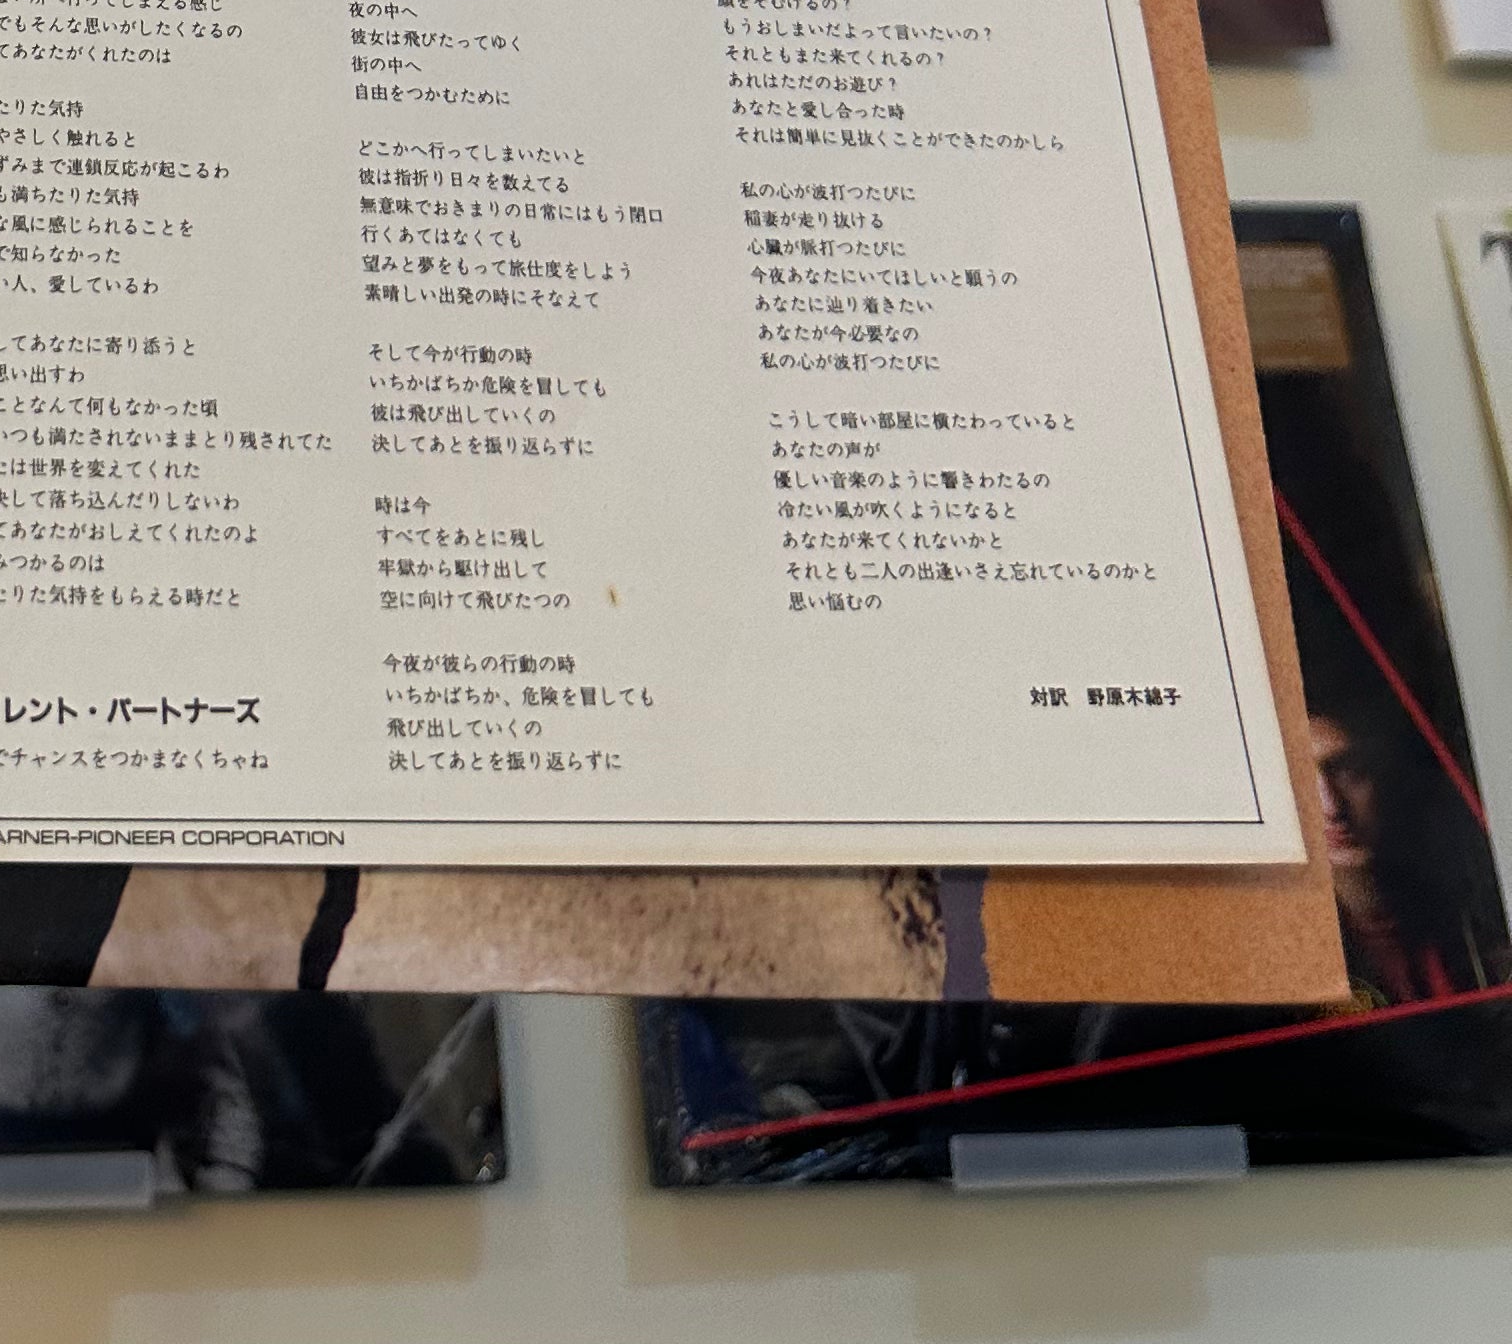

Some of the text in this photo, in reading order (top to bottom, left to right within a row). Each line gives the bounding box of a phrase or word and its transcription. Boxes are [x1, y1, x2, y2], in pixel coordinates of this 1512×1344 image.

[346, 0, 418, 20] 夜の中へ
[349, 53, 422, 74] 街の中へ
[354, 81, 509, 106] 自由をつかむために
[359, 223, 522, 249] 行くあてはなくても
[757, 321, 919, 344] あなたが今必要なの
[367, 342, 533, 366] そして今が行動の時
[770, 438, 881, 460] あなたの声が
[373, 493, 431, 517] 時は今
[376, 525, 545, 550] すべてをあとに残し
[787, 590, 883, 613] 思い悩むの
[1029, 685, 1070, 708] 対訳
[386, 716, 543, 739] 飛び出していくの
[181, 829, 345, 846] CORPORATION
